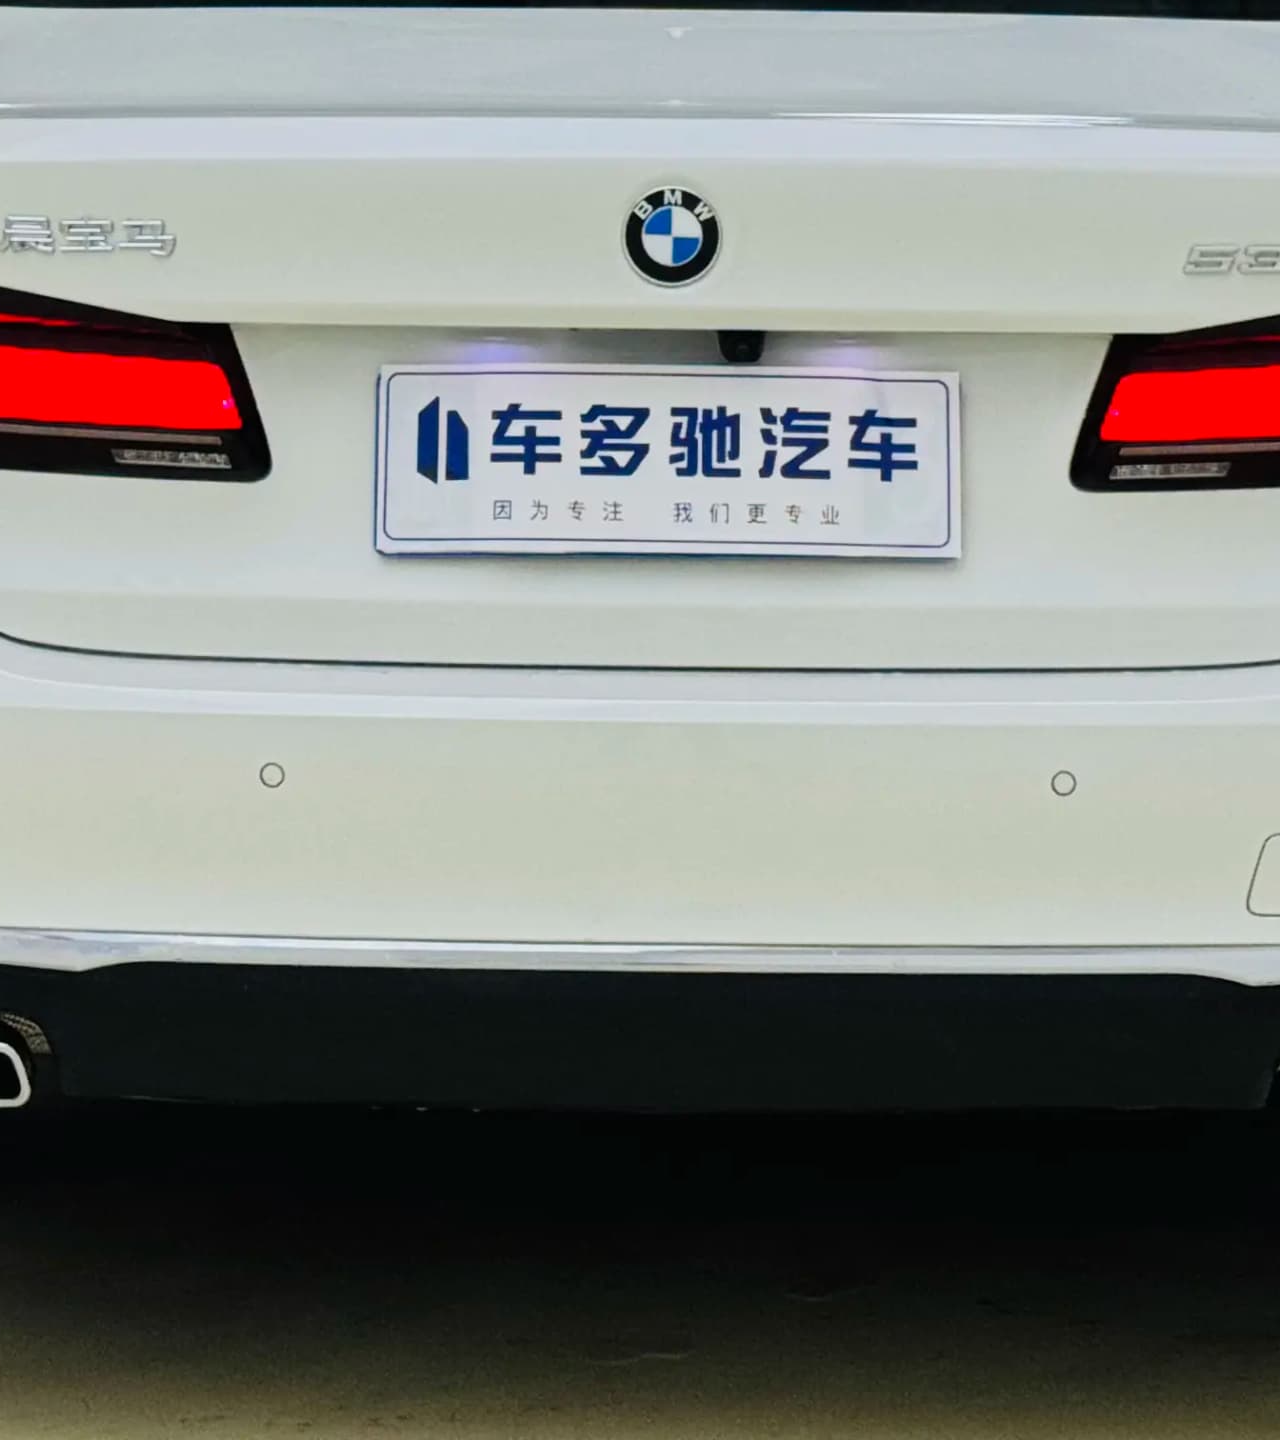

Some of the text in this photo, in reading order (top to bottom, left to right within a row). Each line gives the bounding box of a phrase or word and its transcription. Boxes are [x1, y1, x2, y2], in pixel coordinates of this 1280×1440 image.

[633, 189, 715, 222] BMW
[489, 403, 919, 482] 车多驰汽车
[492, 499, 841, 526] 因为专注 我们更专业
